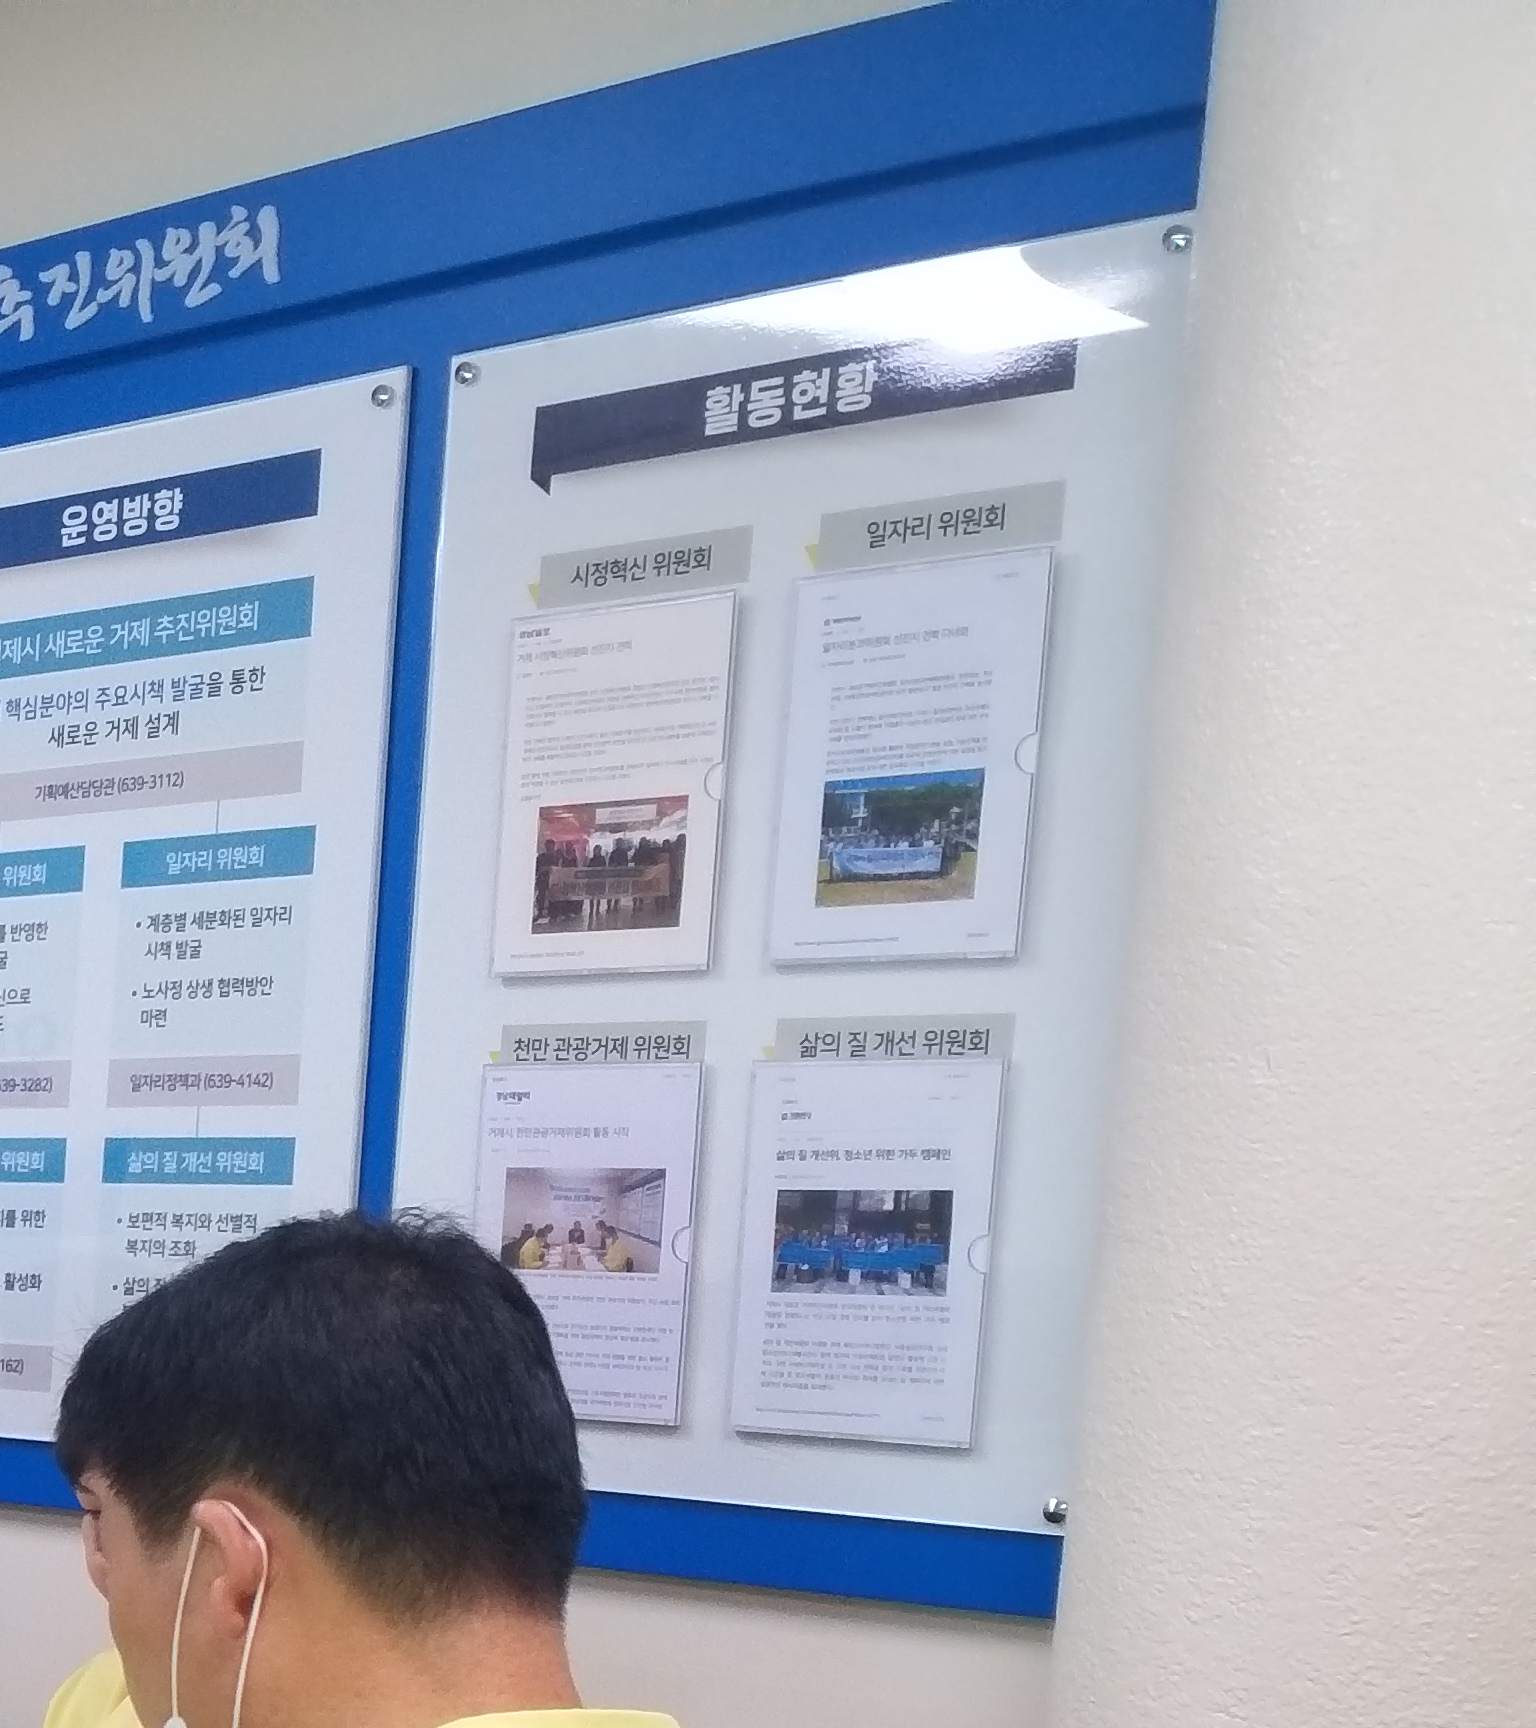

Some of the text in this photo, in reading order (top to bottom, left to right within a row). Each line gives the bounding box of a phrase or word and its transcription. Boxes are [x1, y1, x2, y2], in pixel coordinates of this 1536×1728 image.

[703, 360, 879, 437] 활동현황
[60, 487, 184, 548] 운영방향
[868, 503, 1005, 548] 일자리 위원회
[571, 545, 711, 588] 시정혁신 위원회
[44, 626, 104, 658] 새로운
[110, 618, 150, 649] 거제
[154, 601, 258, 644] 추진위원회
[6, 689, 88, 721] 핵심분야의
[95, 679, 164, 710] 주요시책
[171, 672, 224, 702] 발굴을
[229, 666, 266, 694] 통한
[48, 710, 179, 748] 새로운 거제 설계
[35, 771, 184, 802] 기획예산담당관 (639-3112)
[167, 845, 264, 874] 일자리 위원회
[3, 863, 46, 886] 위원회
[146, 906, 292, 933] 계층별 세분화된 일자리
[10, 922, 48, 942] 반영한
[145, 940, 202, 960] 시책 발굴
[142, 976, 274, 1000] 노사정 상생 협력방안
[140, 1008, 167, 1028] 마련
[514, 1035, 690, 1061] 천만 관광거제 위원회
[800, 1029, 990, 1058] 삶의 질 개선 위원회
[130, 1072, 273, 1092] 일자리정책과 (639-4142)
[1, 1151, 44, 1172] 위원회
[128, 1151, 158, 1173] 삶의
[163, 1151, 177, 1173] 질
[181, 1152, 212, 1173] 개선
[20, 1210, 46, 1228] 위한
[127, 1212, 257, 1234] 보편적 복지와 선별적
[126, 1239, 196, 1259] 복지의 조화
[4, 1273, 42, 1292] 활성화
[123, 1278, 152, 1300] 삶의
